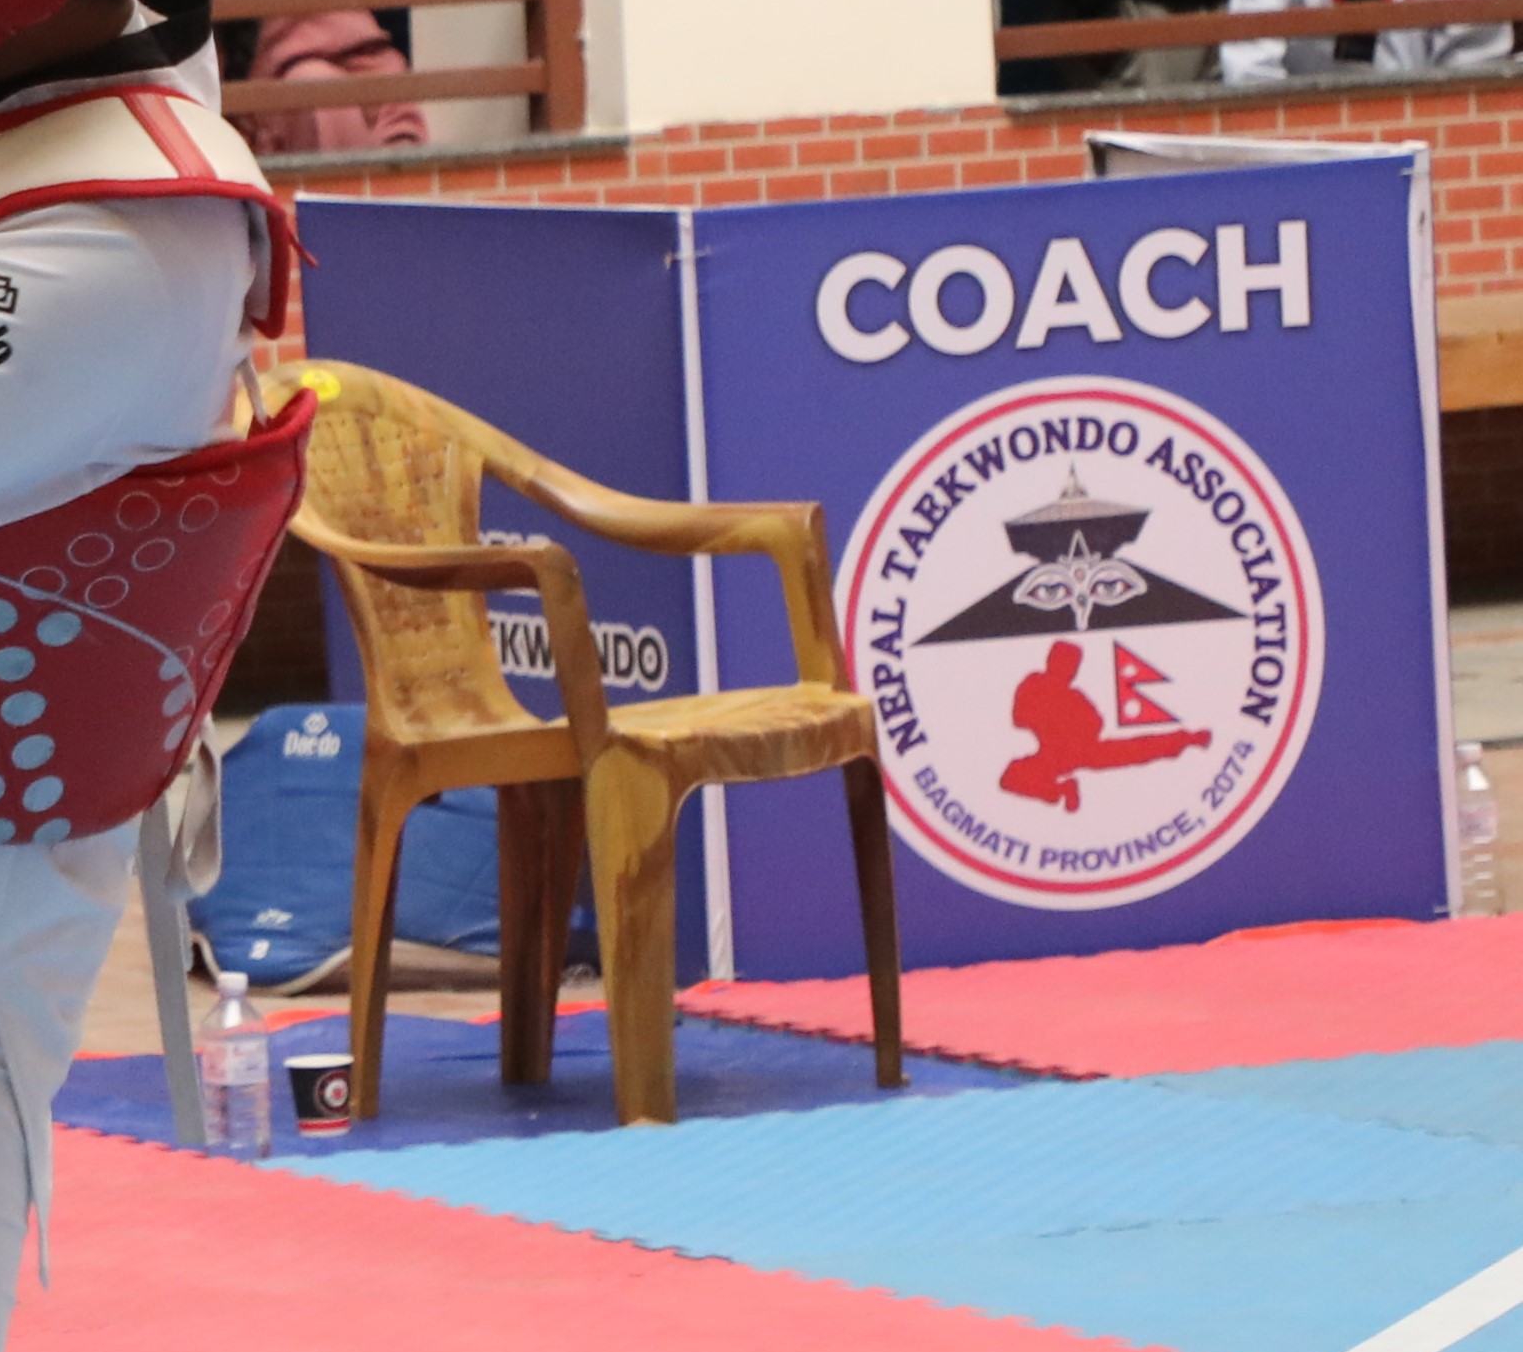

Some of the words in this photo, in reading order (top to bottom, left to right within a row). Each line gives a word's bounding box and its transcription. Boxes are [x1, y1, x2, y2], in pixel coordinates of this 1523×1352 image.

[815, 220, 1311, 364] COACH
[880, 417, 1140, 582] TAEKWONDO
[1145, 436, 1287, 727] ASSOCIATION
[870, 598, 928, 757] NEPAL
[913, 764, 1031, 865] BAGMATI
[1039, 810, 1207, 873] PROVINCE,
[1201, 738, 1255, 811] 2074
